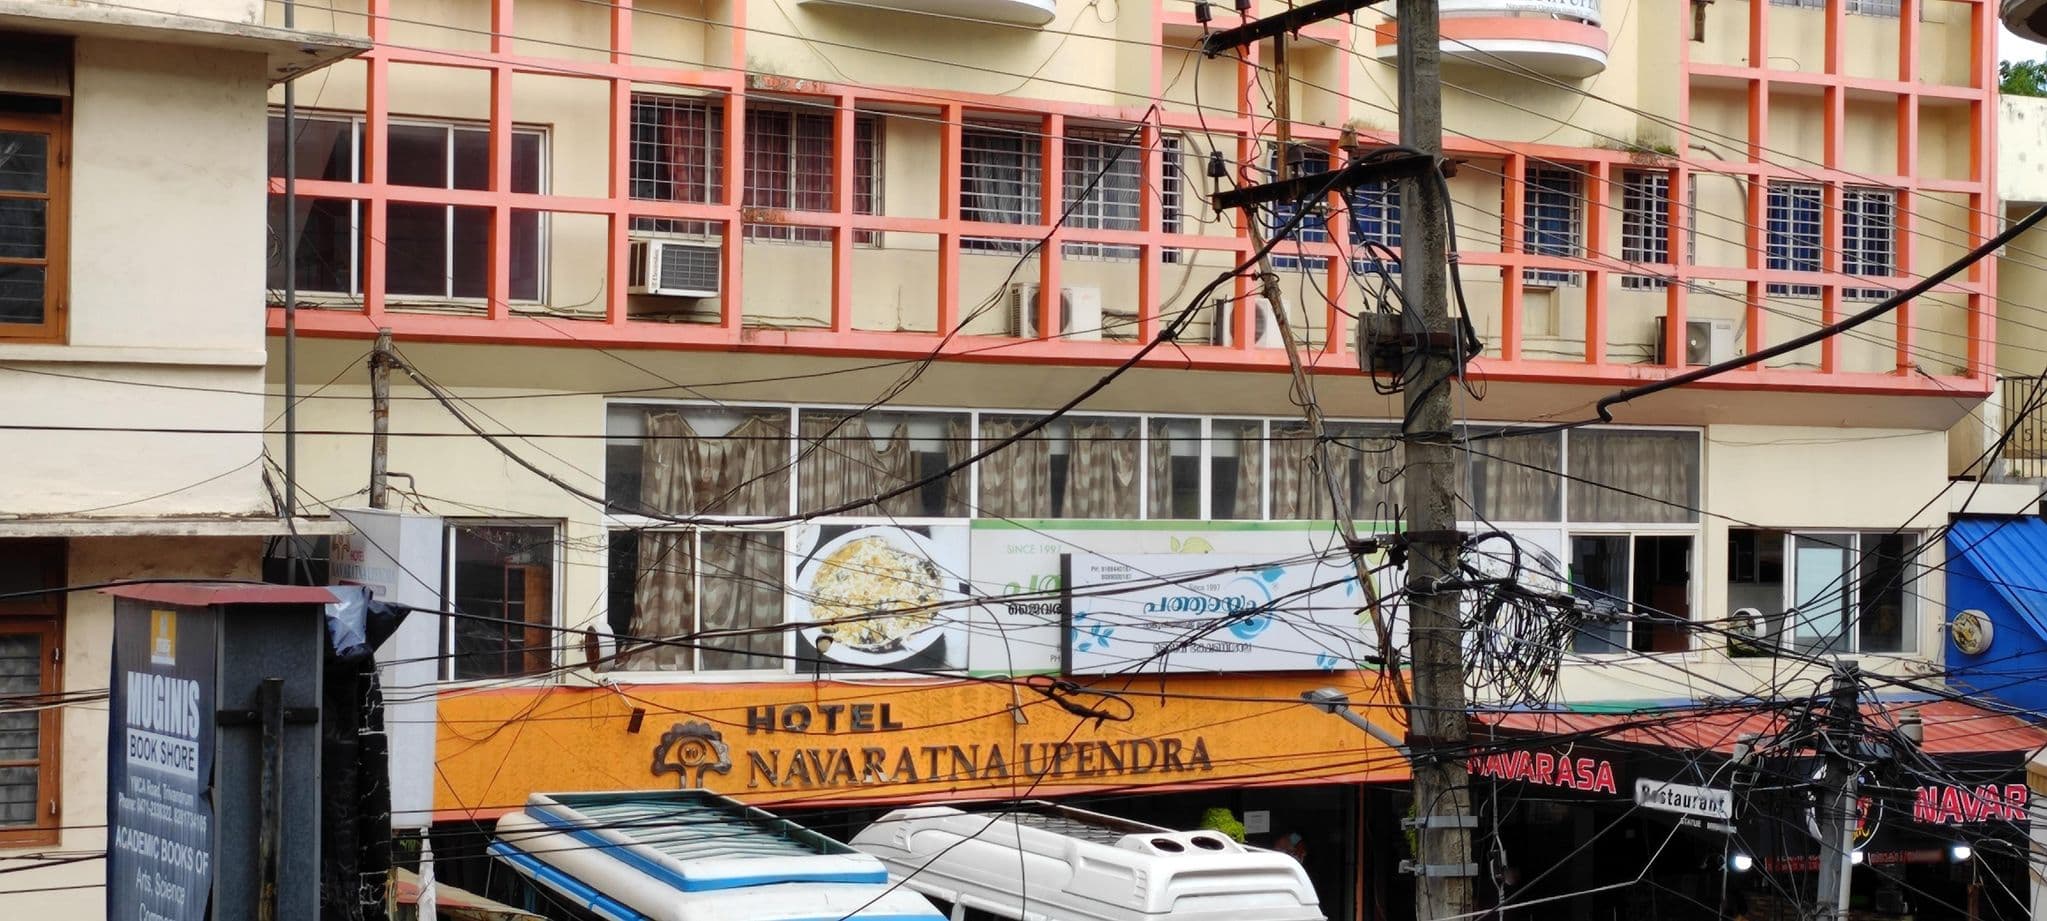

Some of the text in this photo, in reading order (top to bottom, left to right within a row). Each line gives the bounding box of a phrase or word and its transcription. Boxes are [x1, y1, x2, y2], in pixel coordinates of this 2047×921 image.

[1007, 544, 1062, 554] SINCE 1997
[1206, 583, 1221, 591] 1997
[127, 671, 200, 739] MUGINIS
[747, 703, 903, 734] HOTEL
[130, 735, 194, 771] BOOK SHORE
[747, 736, 1213, 788] NAVARATNA UPENDRA
[116, 825, 209, 876] ACADEMIC BOOKS OF
[154, 872, 185, 905] Science
